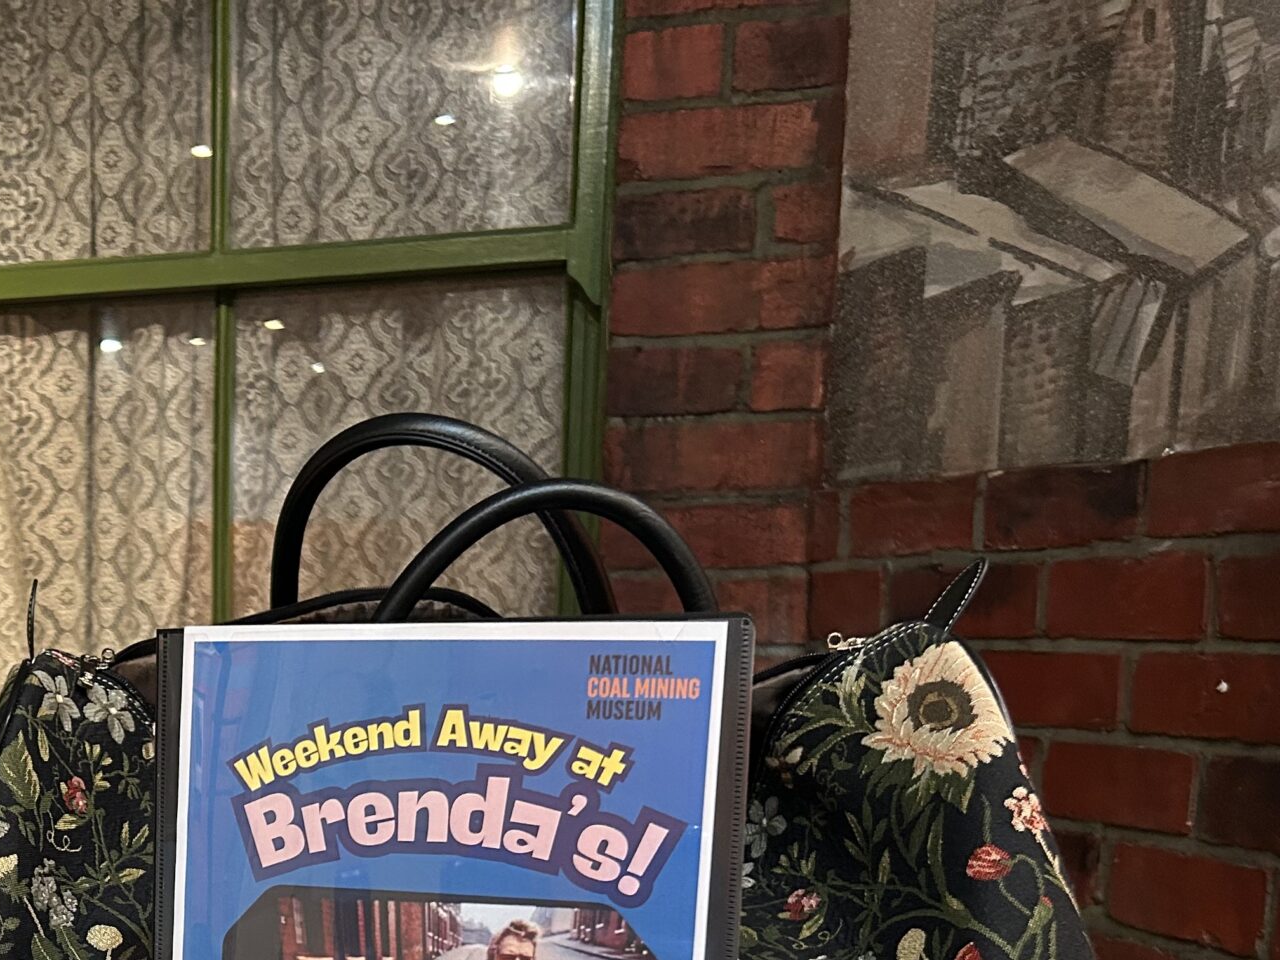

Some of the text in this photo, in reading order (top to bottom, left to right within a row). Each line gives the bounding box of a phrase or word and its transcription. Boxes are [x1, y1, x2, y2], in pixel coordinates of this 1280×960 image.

[588, 654, 674, 676] NATIONAL
[587, 676, 701, 700] COAL MINING
[586, 700, 662, 722] MUSEUM
[233, 709, 631, 792] Weekend Away at
[242, 775, 671, 897] Brenda's!
